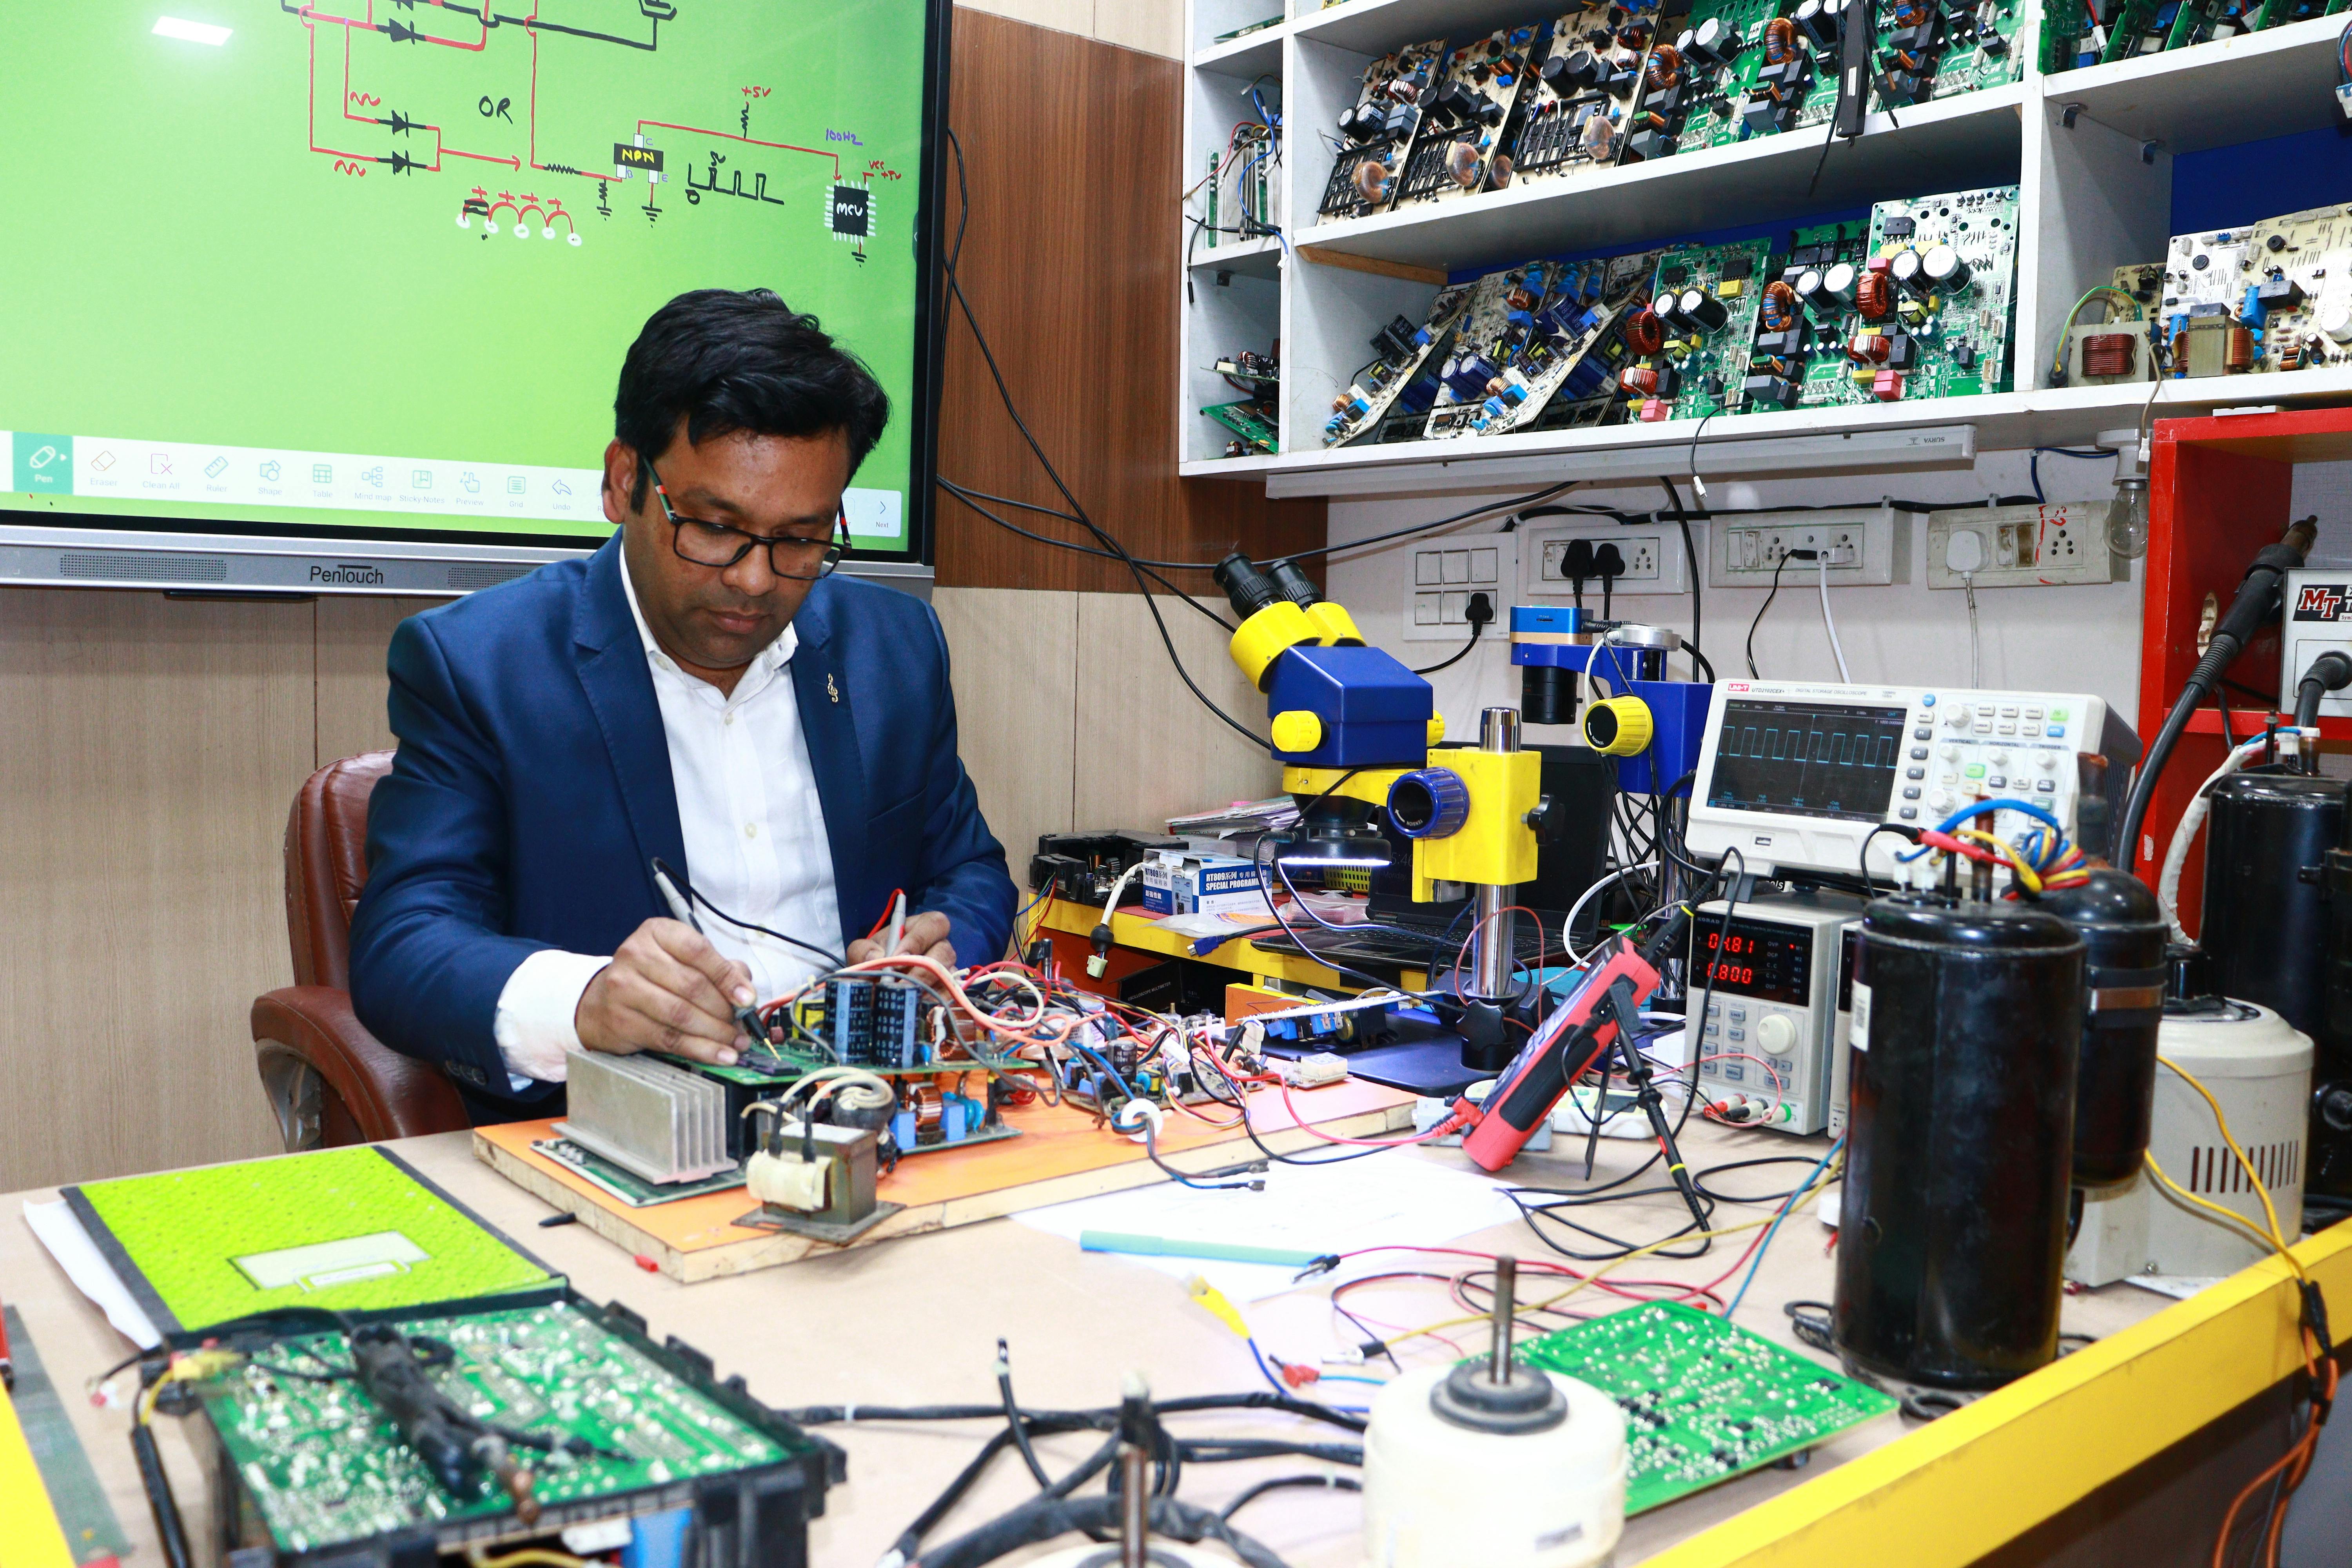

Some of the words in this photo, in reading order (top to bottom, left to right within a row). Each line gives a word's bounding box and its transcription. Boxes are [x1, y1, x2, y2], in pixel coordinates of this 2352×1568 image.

[479, 96, 513, 124] OR
[622, 149, 654, 163] NPN
[35, 474, 53, 483] Pen
[90, 477, 117, 486] Eraser
[143, 481, 166, 489] Clean
[207, 484, 227, 492] Ruler
[258, 487, 282, 496] Shape
[312, 490, 333, 498] Table
[354, 492, 373, 501] Mind
[456, 497, 484, 506] Preview
[310, 564, 383, 584] PenTouch
[1206, 881, 1229, 891] SPECIAL
[1128, 989, 1151, 1001] OSCILLOSCOPE
[1151, 982, 1171, 992] MULTIMETER
